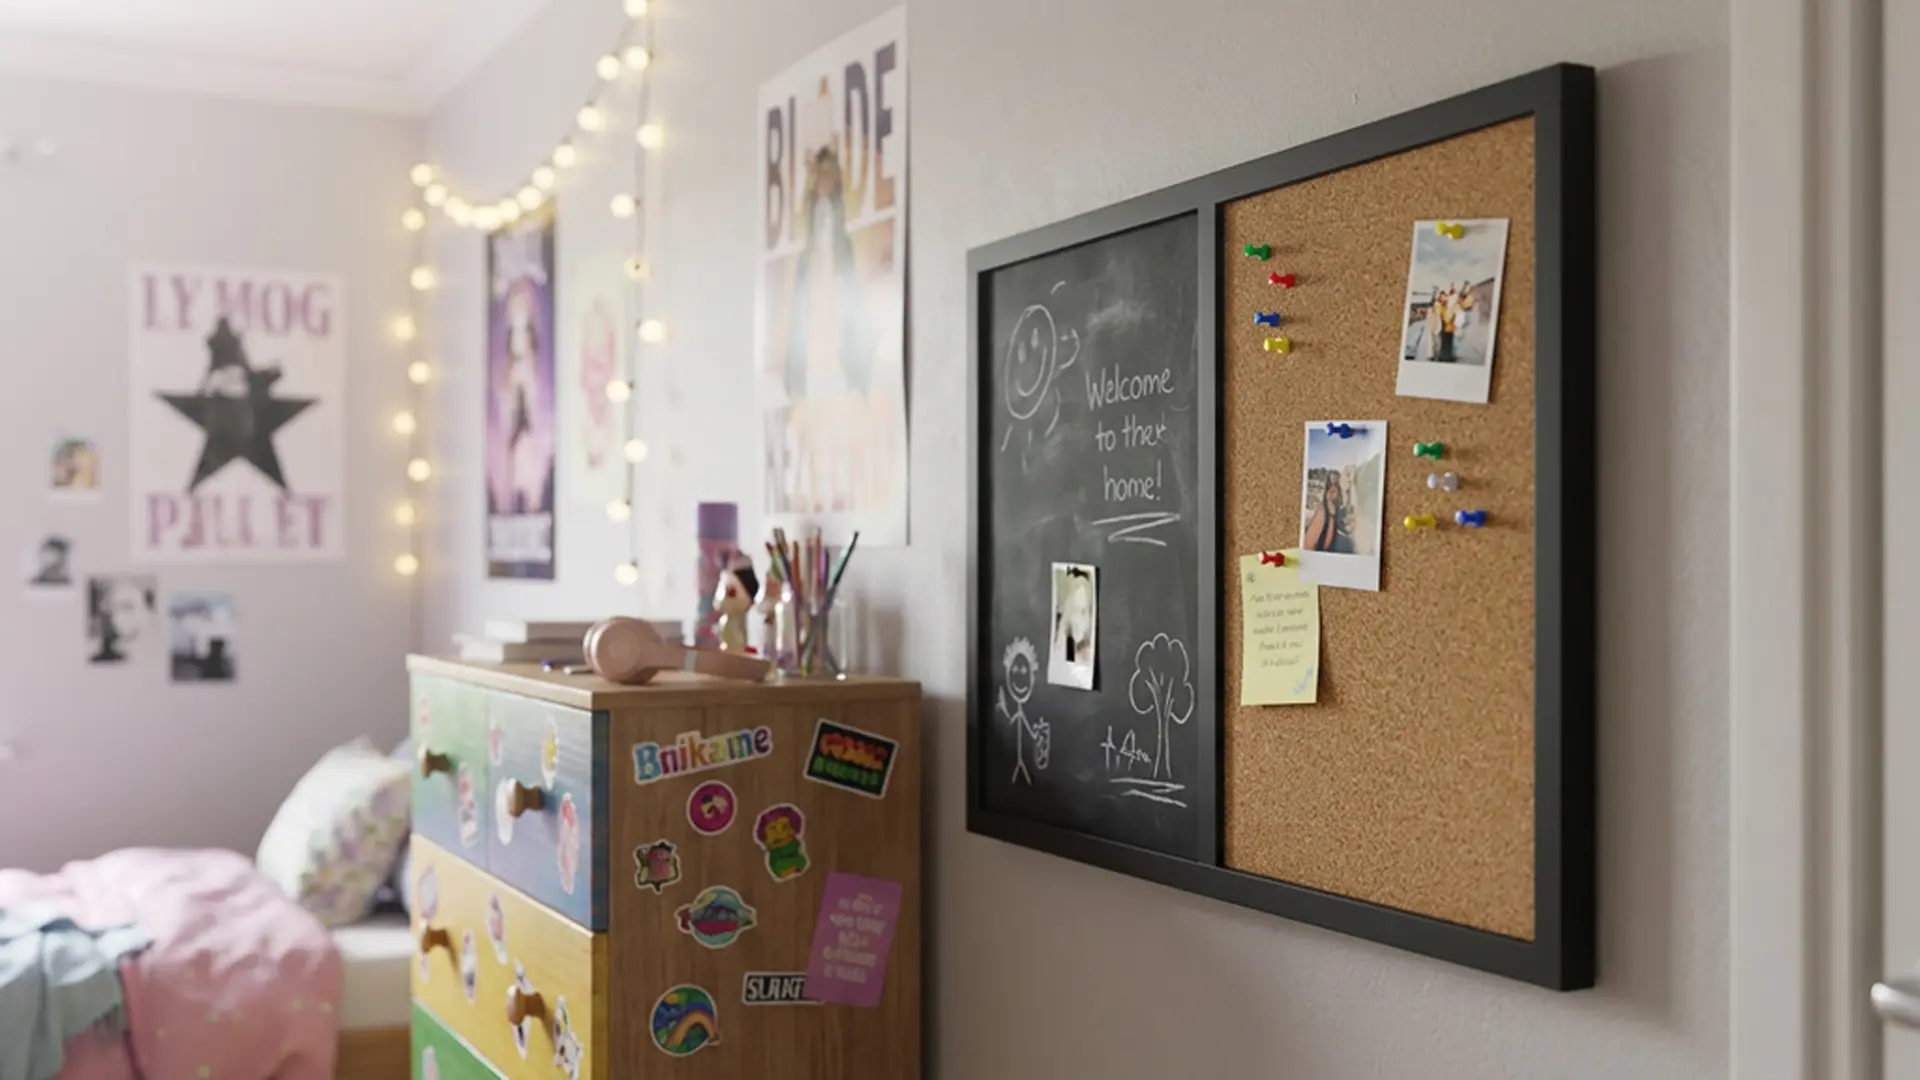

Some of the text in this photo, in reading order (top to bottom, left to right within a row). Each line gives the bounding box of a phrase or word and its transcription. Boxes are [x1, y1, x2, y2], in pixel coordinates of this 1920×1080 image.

[766, 40, 898, 251] BLDE
[1085, 363, 1174, 411] Welcome
[1095, 420, 1116, 452] to
[1104, 459, 1161, 501] home!
